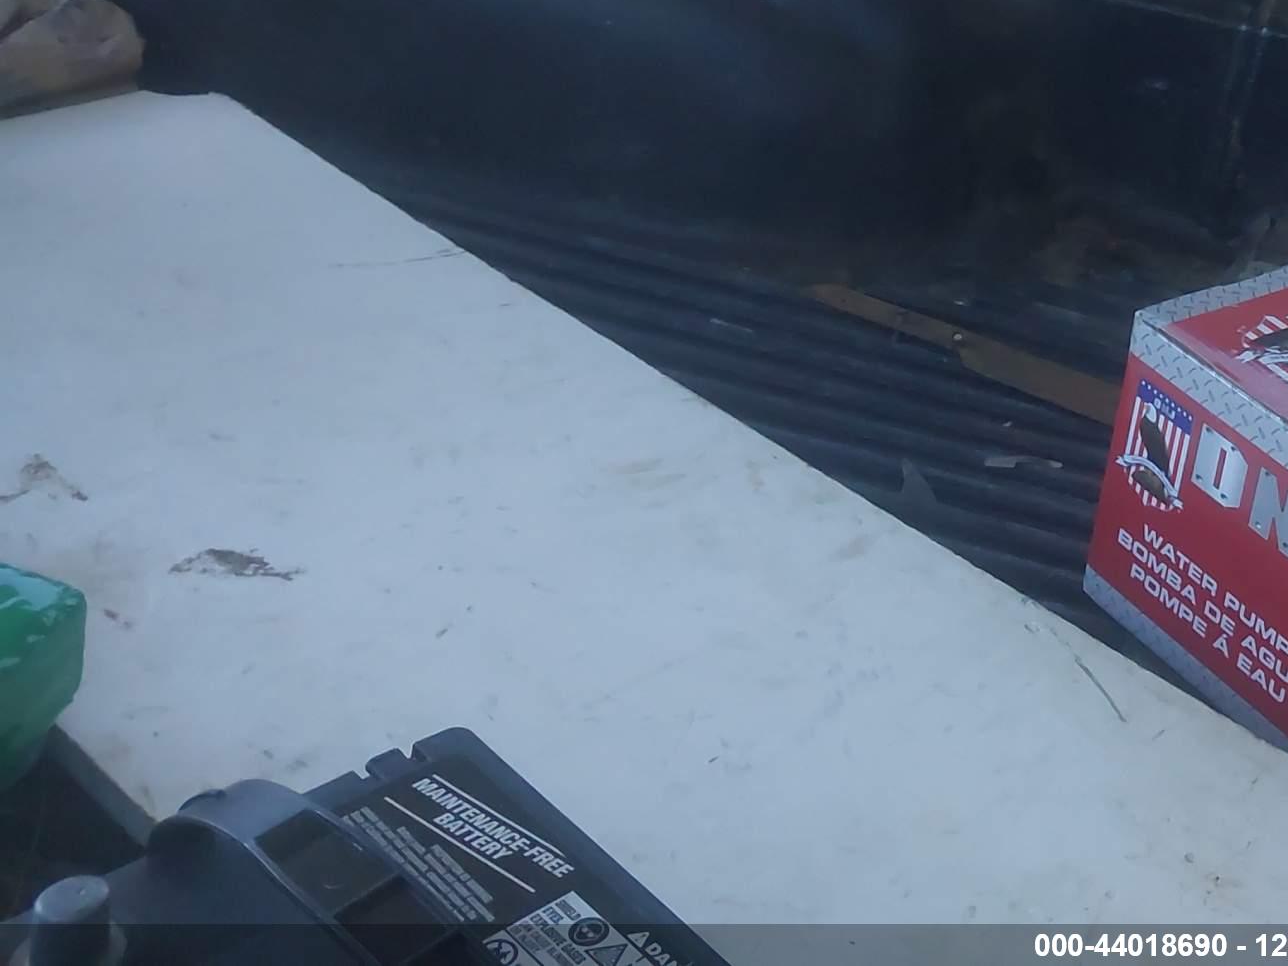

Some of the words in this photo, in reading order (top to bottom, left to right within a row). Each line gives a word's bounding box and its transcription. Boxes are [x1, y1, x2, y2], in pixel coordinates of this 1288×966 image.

[1118, 528, 1196, 606] BOMBA
[1204, 600, 1236, 637] DE
[1144, 523, 1218, 597] WATER
[1130, 563, 1208, 638] POMPE
[1237, 653, 1286, 703] EAU
[412, 777, 575, 878] MAINTENANCE-FREE
[433, 813, 513, 860] BATTERY
